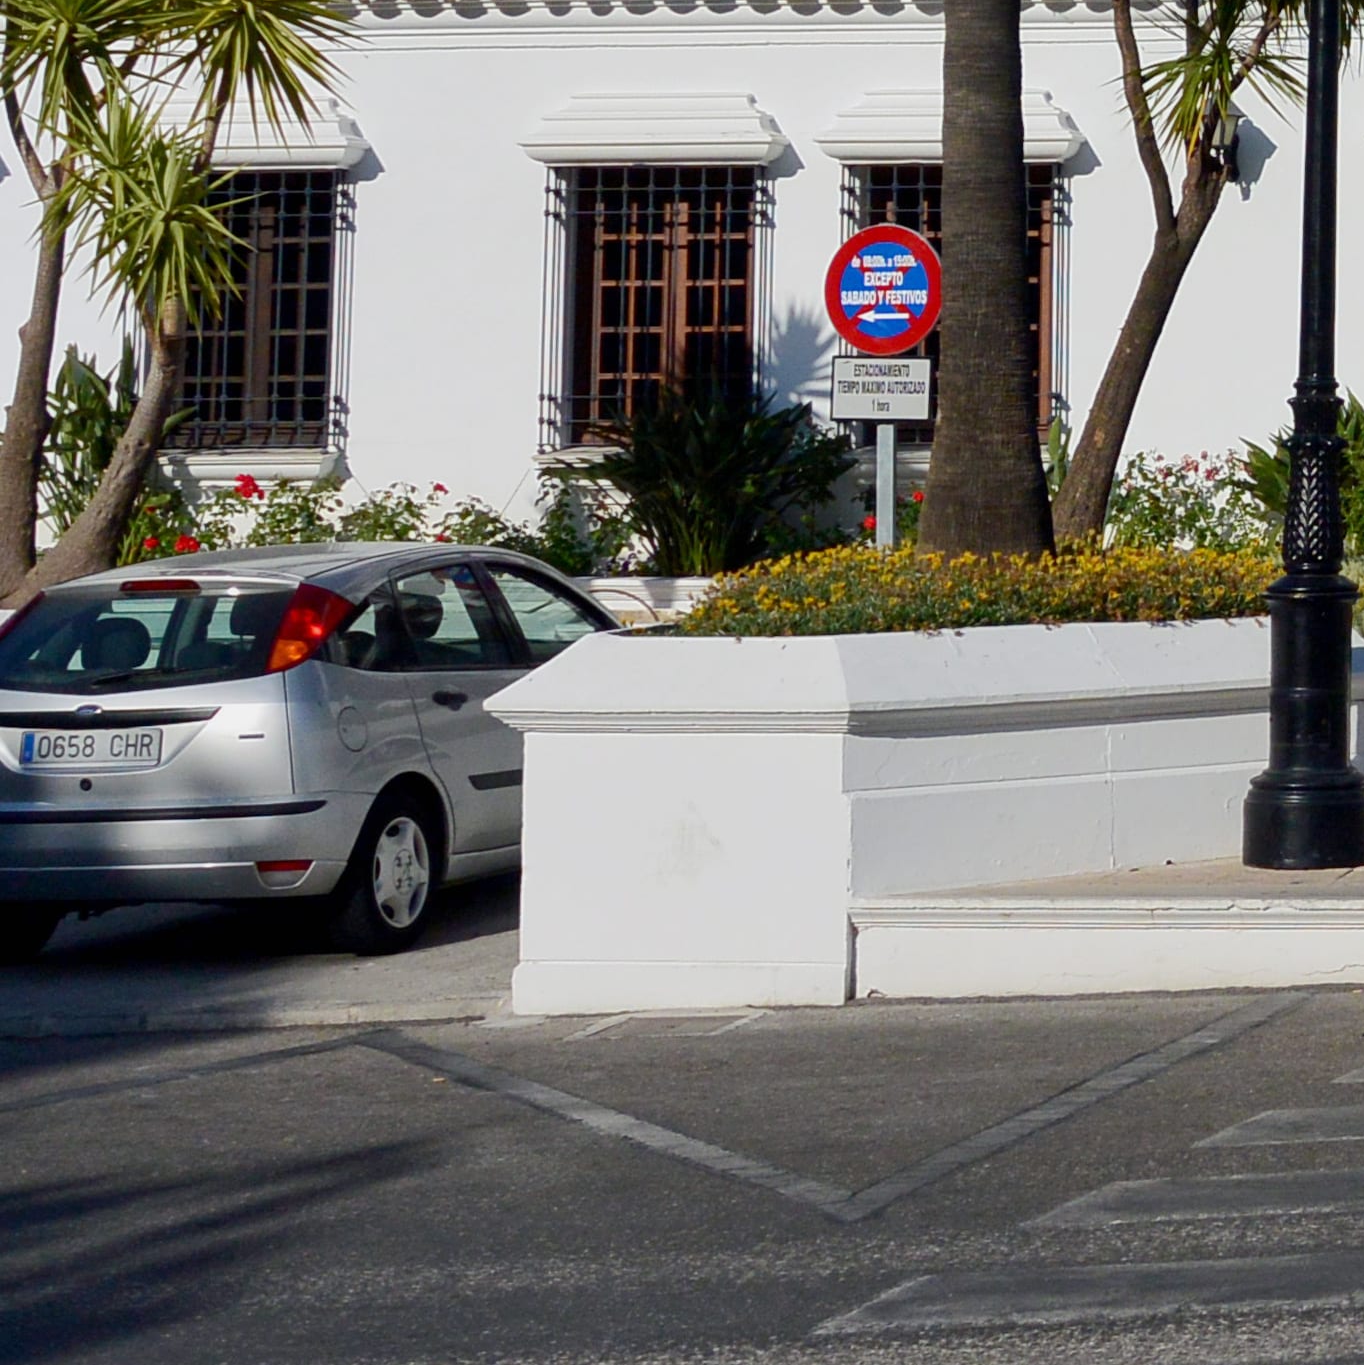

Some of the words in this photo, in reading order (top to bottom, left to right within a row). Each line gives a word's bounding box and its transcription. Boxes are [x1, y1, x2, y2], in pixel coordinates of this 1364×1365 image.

[863, 272, 904, 286] EXCEPTO
[841, 291, 876, 305] SABADO
[877, 290, 885, 305] Y
[885, 290, 928, 305] FESTIVOS
[853, 364, 910, 377] ESTACIONAMIENTO
[838, 380, 860, 394] TIEMPO
[887, 380, 926, 394] AUTORIZADO
[37, 734, 95, 759] 0658
[109, 733, 154, 758] CHR
